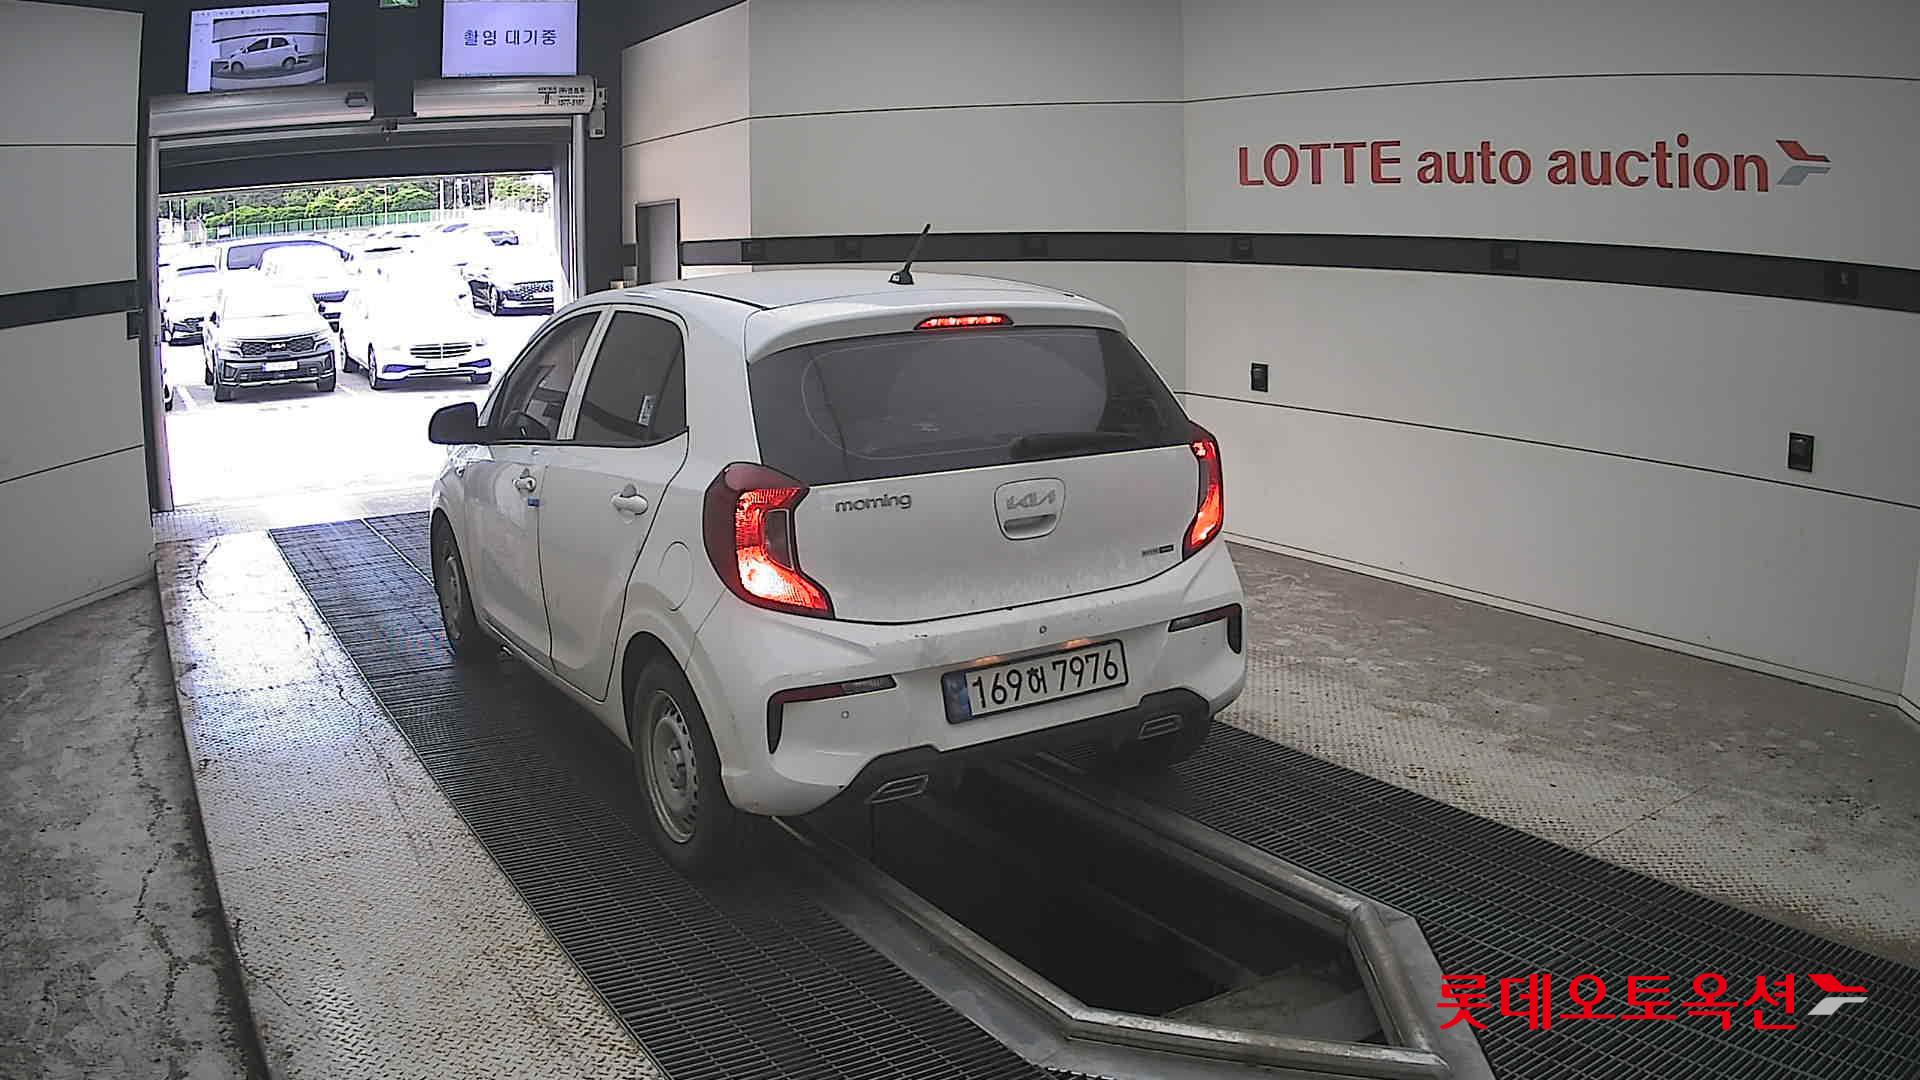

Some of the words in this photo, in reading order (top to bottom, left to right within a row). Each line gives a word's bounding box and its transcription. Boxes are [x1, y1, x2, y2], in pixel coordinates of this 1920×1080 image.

[505, 29, 558, 46] 대기중
[1239, 140, 1402, 186] LOTTE
[1416, 140, 1533, 185] auto
[1547, 133, 1770, 192] auction
[835, 493, 912, 512] morning
